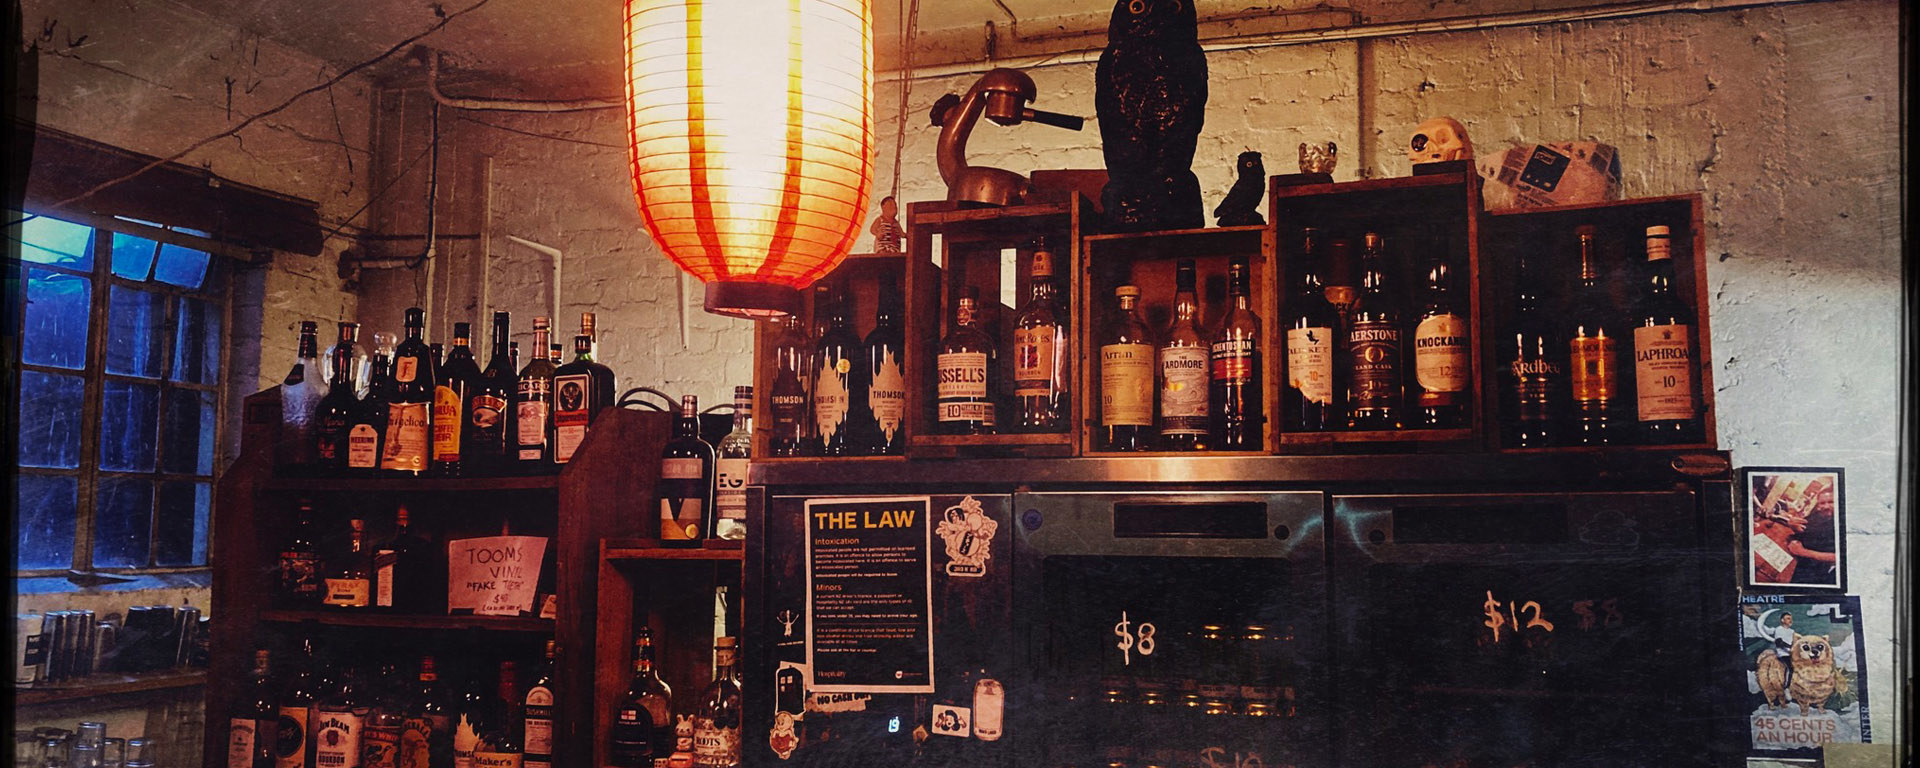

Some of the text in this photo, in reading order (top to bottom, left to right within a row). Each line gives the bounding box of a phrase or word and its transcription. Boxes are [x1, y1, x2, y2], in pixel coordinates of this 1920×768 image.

[1637, 348, 1688, 362] LAPHROA
[1165, 360, 1204, 370] ARDMORE
[1664, 376, 1676, 388] 10
[772, 396, 804, 404] THOMSON
[1104, 395, 1113, 405] 10
[949, 406, 959, 417] 10
[815, 510, 915, 530] THE LAW
[466, 547, 523, 564] TOOMS
[1742, 595, 1785, 603] HEATRE
[1484, 590, 1554, 643] $12
[1115, 611, 1156, 665] $8
[817, 695, 830, 705] NO
[832, 693, 853, 704] CASH
[331, 717, 350, 734] BEAM
[1755, 718, 1837, 731] 45 CENTS
[1756, 732, 1833, 744] AN HOUR
[477, 757, 515, 766] Maker's
